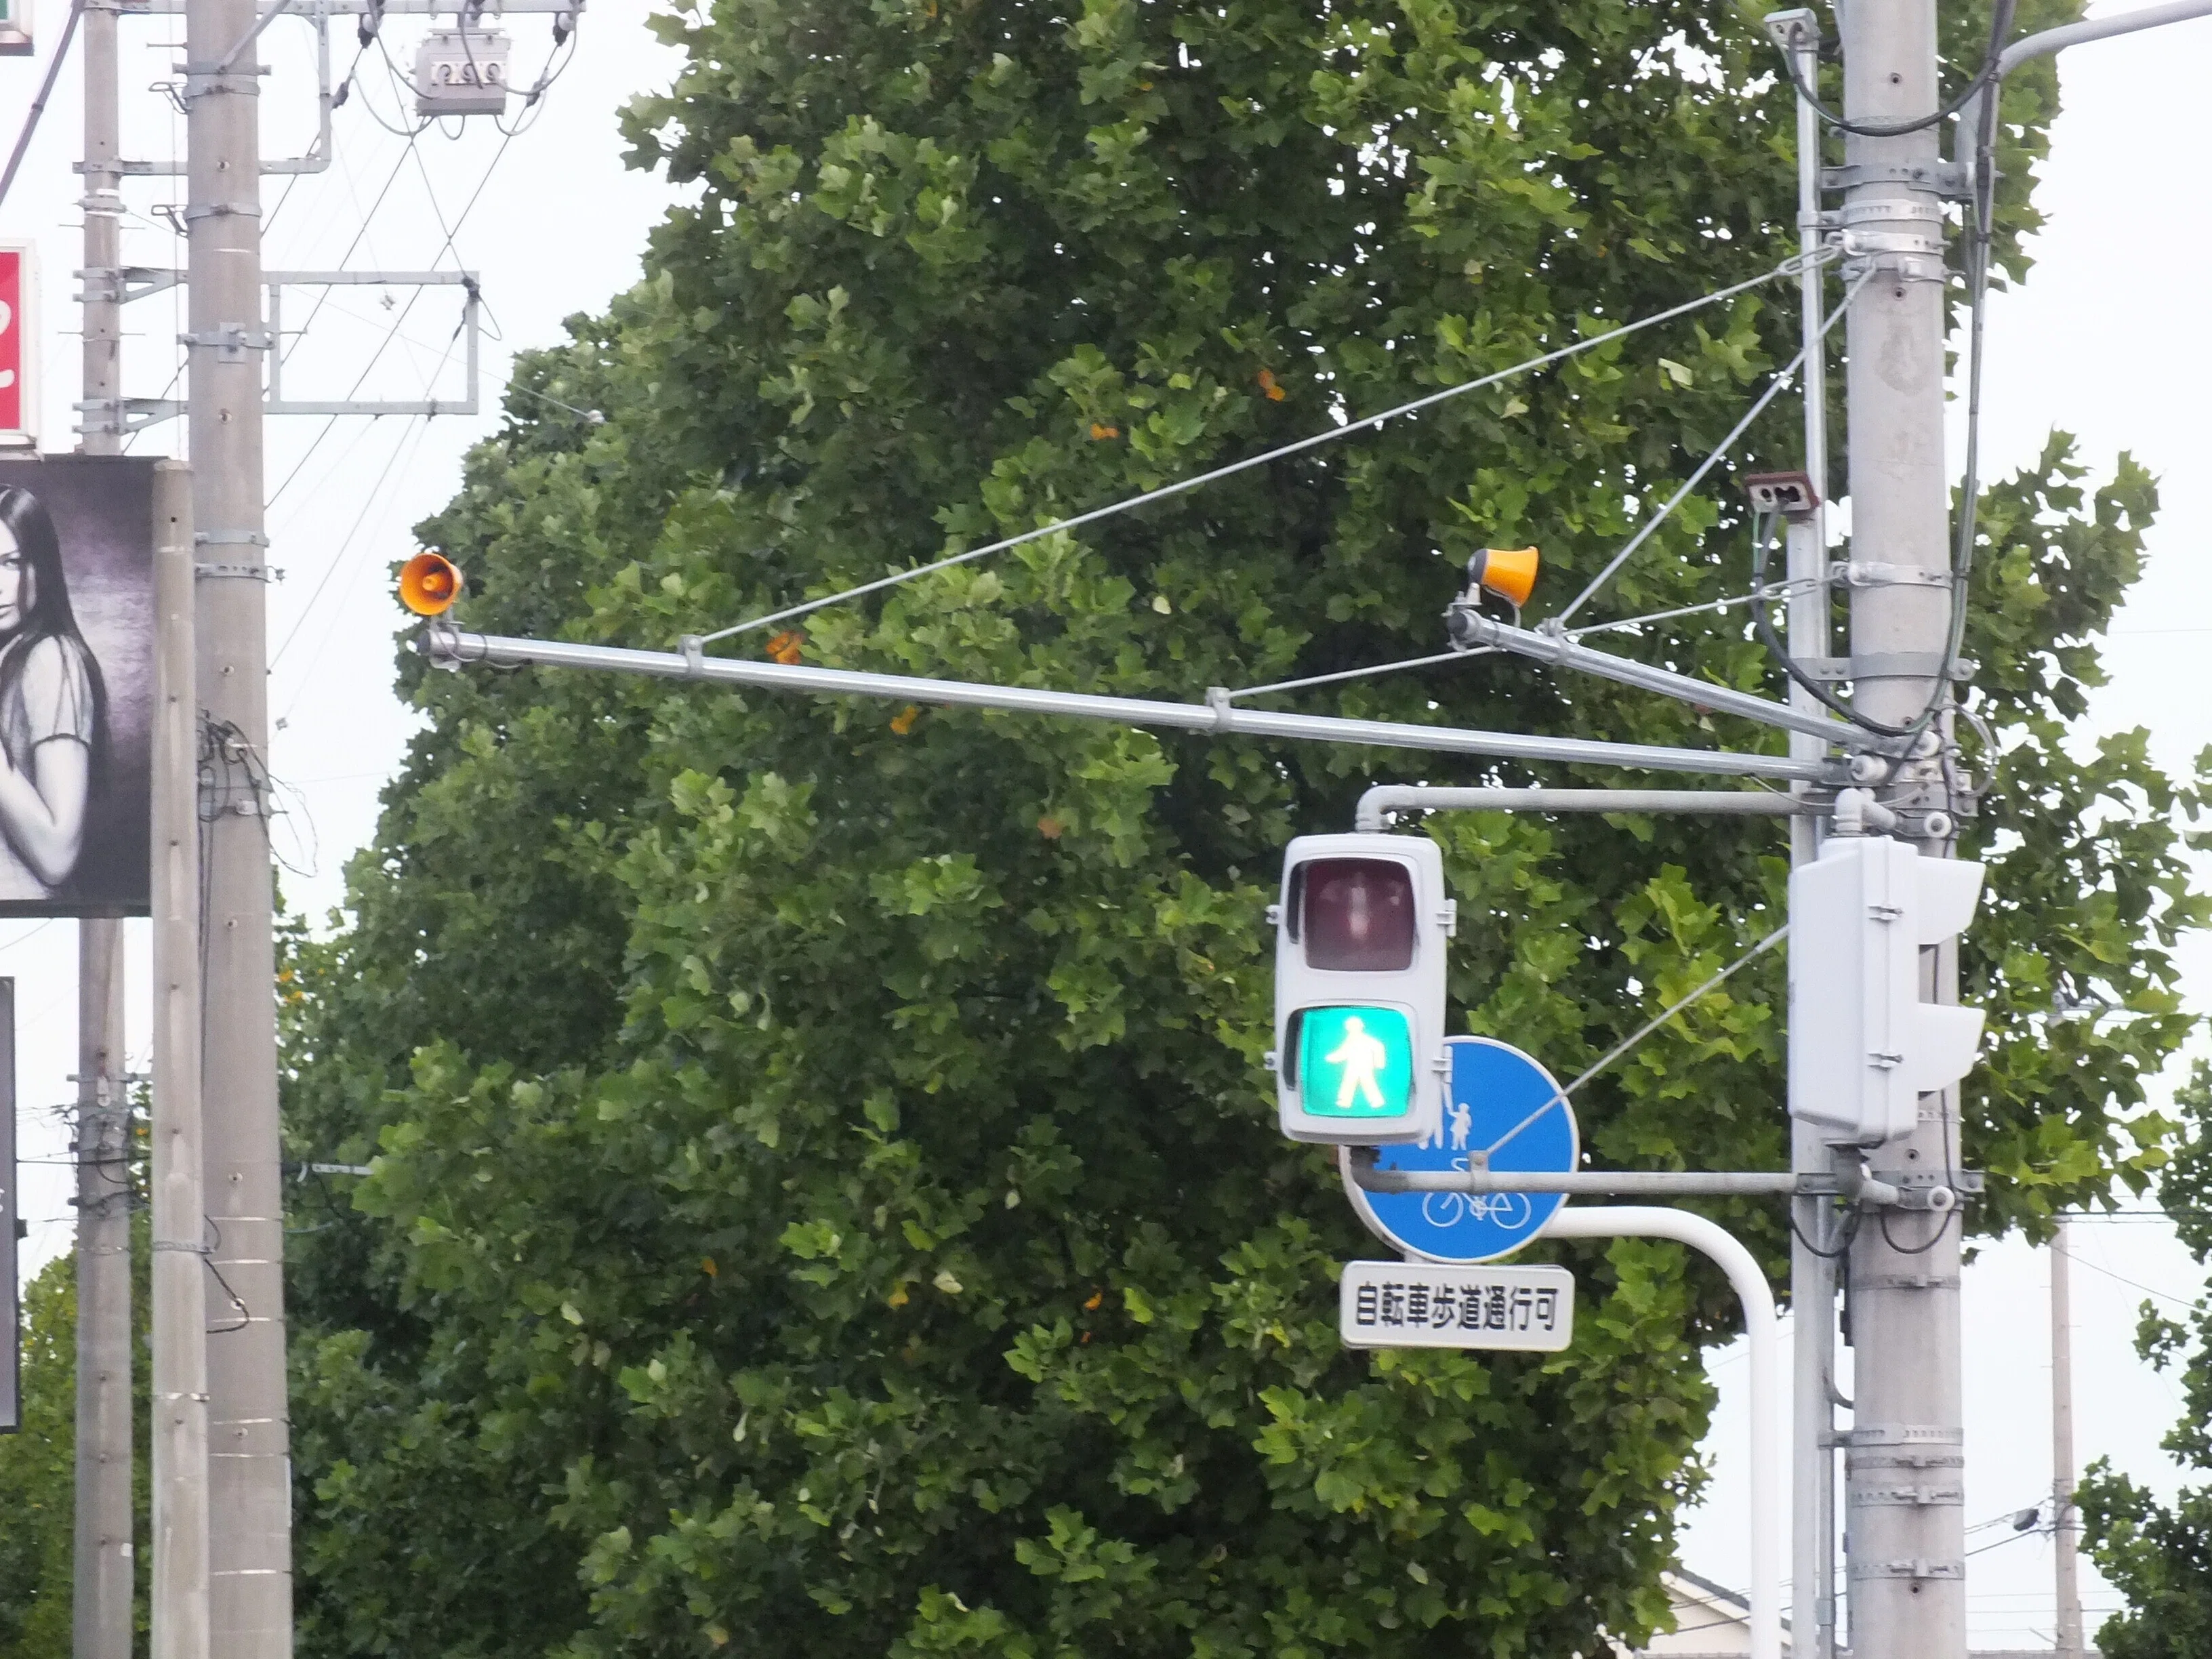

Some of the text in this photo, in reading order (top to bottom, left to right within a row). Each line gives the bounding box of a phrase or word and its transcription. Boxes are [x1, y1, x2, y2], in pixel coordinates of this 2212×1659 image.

[1357, 1282, 1558, 1330] 自転車歩道通行可
